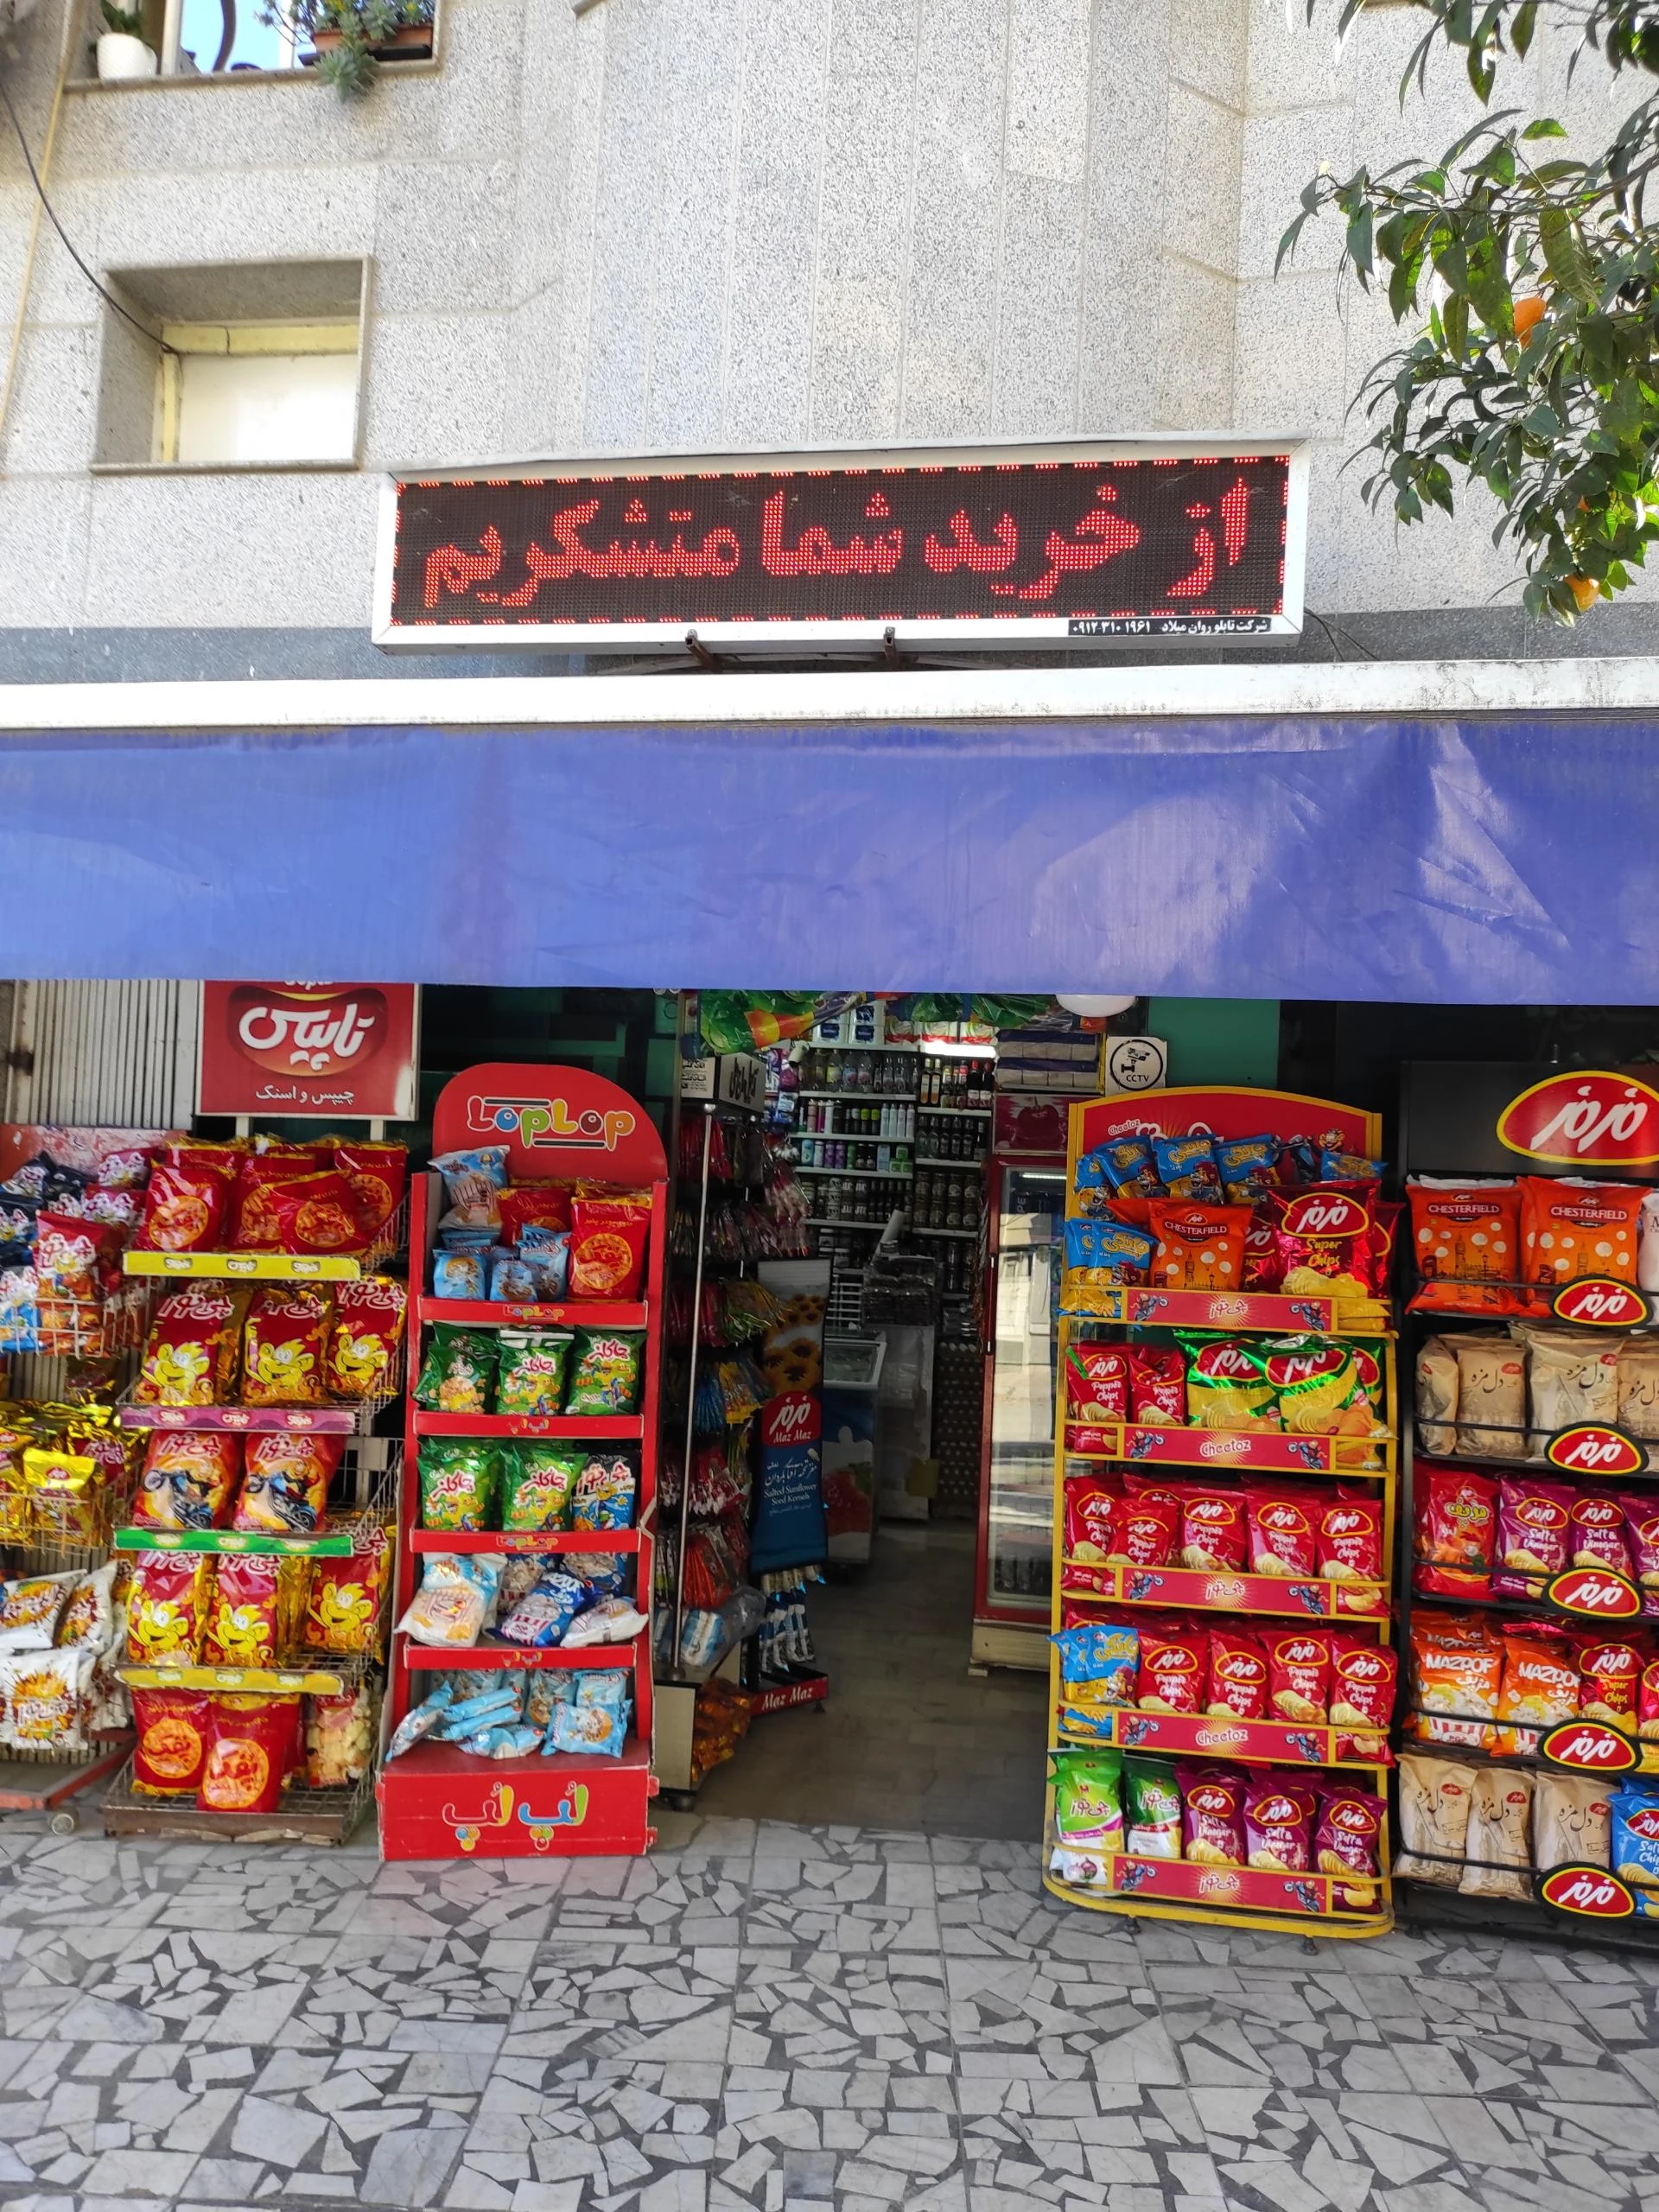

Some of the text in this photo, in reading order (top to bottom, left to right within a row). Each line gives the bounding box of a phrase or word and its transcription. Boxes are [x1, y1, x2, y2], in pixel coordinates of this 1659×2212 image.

[423, 476, 1249, 607] از خرید شما متشکریم
[1161, 620, 1186, 632] میلاد
[1188, 620, 1211, 635] روان
[1215, 620, 1234, 633] تابلو
[1236, 618, 1268, 634] شرکت
[1126, 1074, 1150, 1083] CCTV
[256, 1085, 354, 1105] چیپس و اسنک
[1108, 1118, 1141, 1136] Cheetoz
[1529, 1085, 1648, 1153] مزمز
[1296, 1198, 1350, 1233] مزمز
[1428, 1204, 1499, 1214] CHESTERFIELD
[1551, 1207, 1627, 1220] CHESTERFIELD
[1164, 1220, 1227, 1236] CHESTERFIELD
[1306, 1238, 1341, 1251] Super
[1307, 1254, 1341, 1268] Chips
[1570, 1286, 1627, 1319] مزمز
[1089, 1357, 1118, 1377] مزمز
[1091, 1381, 1121, 1392] Pepper
[1096, 1391, 1119, 1402] Chips
[770, 1395, 811, 1434] مزمز
[773, 1430, 812, 1443] Maz Maz
[1200, 1439, 1251, 1458] Cheetoz
[1564, 1434, 1622, 1467] مزمز
[1190, 1501, 1223, 1517] مزمز
[1269, 1507, 1296, 1526] مزمز
[1524, 1502, 1556, 1520] مزمز
[1580, 1503, 1613, 1521] مزمز
[1192, 1524, 1223, 1535] Pepper
[1331, 1511, 1357, 1533] مزمز
[1197, 1535, 1220, 1544] Chips
[1268, 1532, 1297, 1545] Pepper
[1332, 1538, 1363, 1548] Pepper
[1523, 1539, 1560, 1551] Vinegar
[1583, 1539, 1621, 1550] Vinegar
[1273, 1542, 1293, 1554] Chips
[1336, 1548, 1358, 1559] Chips
[1564, 1576, 1624, 1608] مزمز
[1154, 1650, 1184, 1669] مزمز
[1286, 1642, 1314, 1661] مزمز
[1225, 1656, 1256, 1676] مزمز
[1344, 1656, 1377, 1676] مزمز
[1426, 1653, 1494, 1671] MAZPOF
[1592, 1648, 1630, 1672] مزمز
[1155, 1675, 1186, 1685] Pepper
[1287, 1667, 1319, 1678] Pepper
[1224, 1681, 1256, 1695] Pepper
[1293, 1679, 1316, 1690] Chips
[1345, 1683, 1376, 1694] Pepper
[1601, 1680, 1628, 1690] Super
[762, 1687, 813, 1710] Maz Maz
[1227, 1694, 1252, 1708] Chips
[1350, 1694, 1374, 1706] Chips
[1605, 1693, 1627, 1704] Chips
[1195, 1729, 1248, 1745] Cheetoz
[1559, 1730, 1617, 1761] مزمز
[1197, 1789, 1225, 1809] مزمز
[1265, 1798, 1294, 1821] مزمز
[1337, 1805, 1366, 1829] مزمز
[1261, 1839, 1296, 1851] Vinegar
[1558, 1875, 1616, 1908] مزمز
